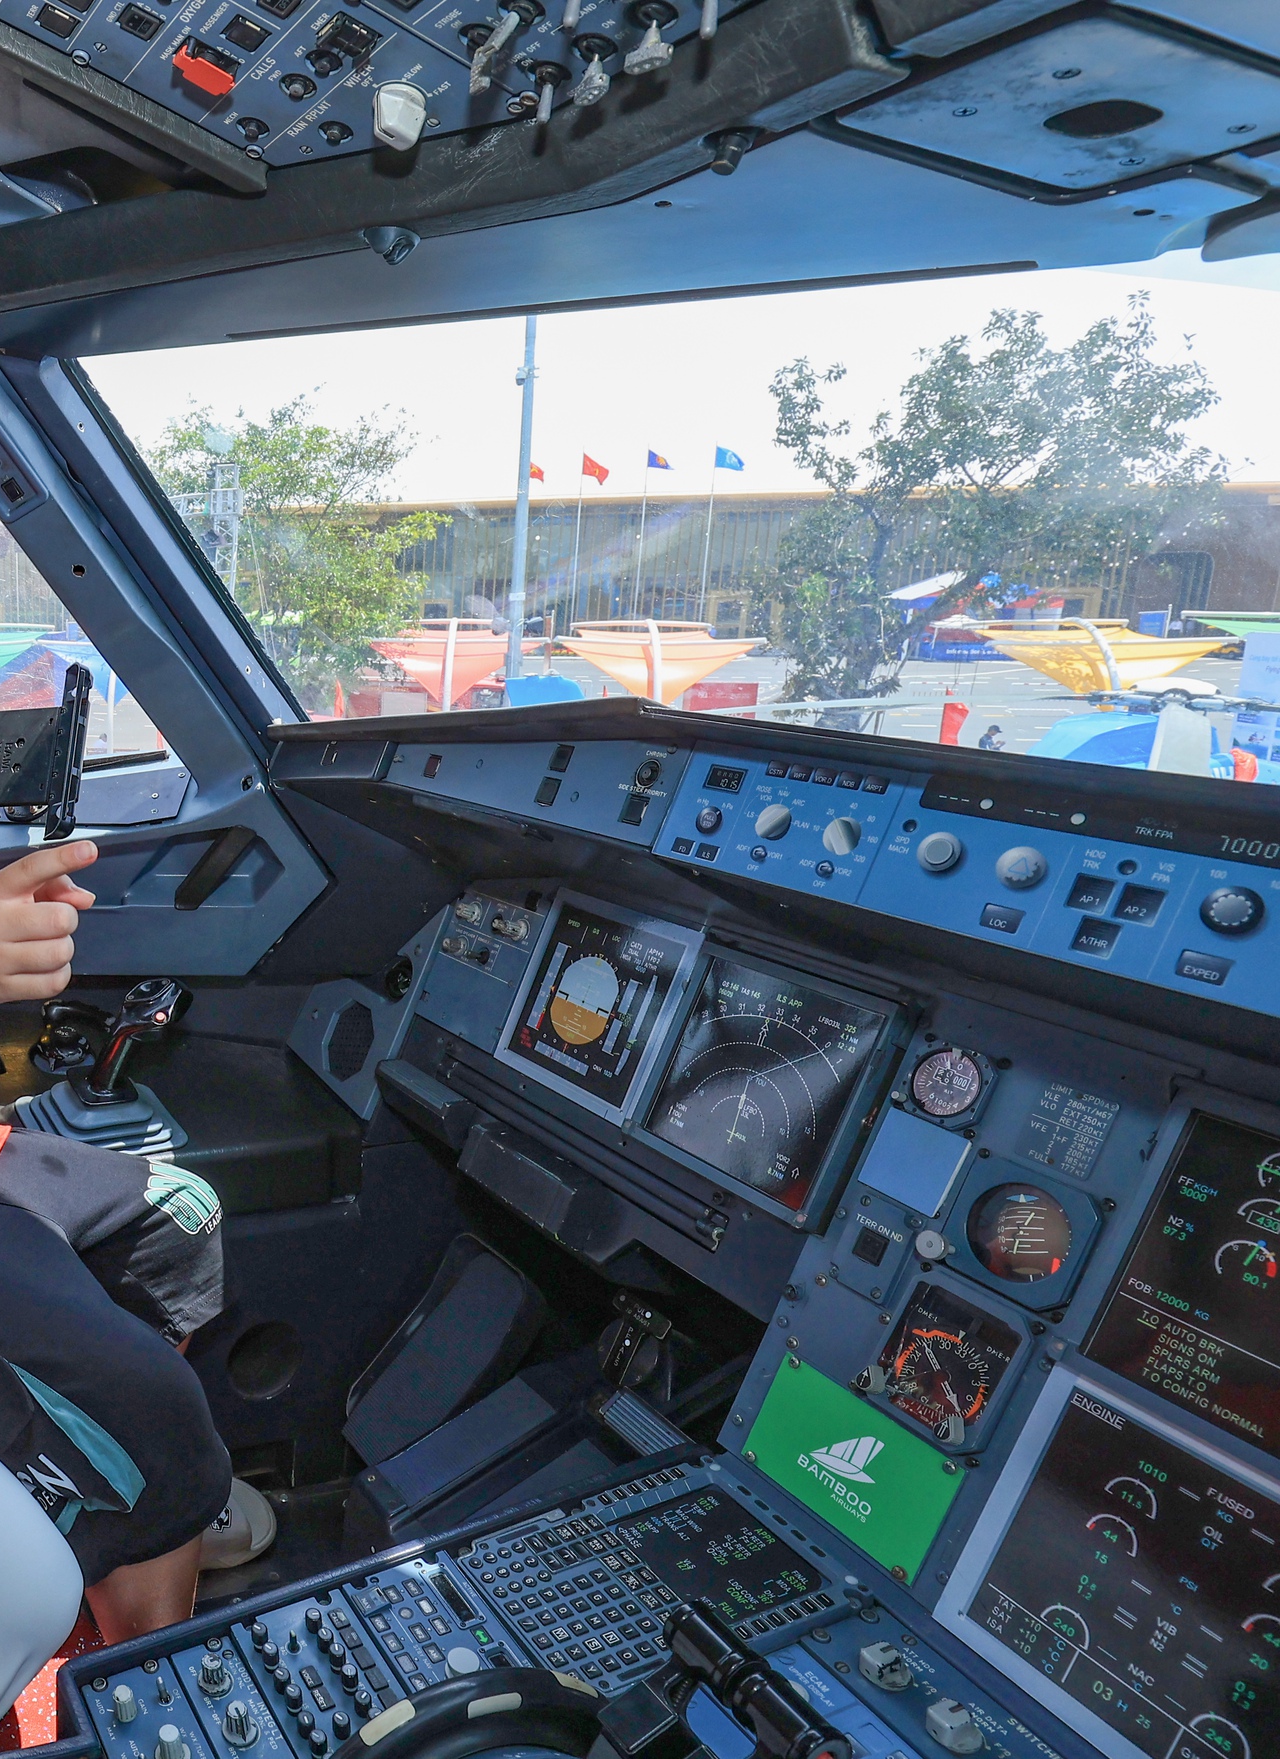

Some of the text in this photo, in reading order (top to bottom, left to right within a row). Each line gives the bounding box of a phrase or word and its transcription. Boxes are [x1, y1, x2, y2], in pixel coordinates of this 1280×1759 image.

[26, 4, 39, 20] TERR
[200, 3, 230, 35] PASSENGER
[434, 10, 463, 29] STROBE
[310, 13, 330, 31] EMER
[537, 21, 553, 33] OFF
[601, 19, 616, 29] ON
[293, 45, 307, 58] AFT
[250, 57, 277, 81] CALLS
[268, 69, 282, 82] FWD
[343, 64, 375, 89] WIPER
[404, 64, 424, 80] SLOW
[361, 76, 374, 88] OFF
[433, 80, 452, 97] FAST
[223, 111, 238, 125] MECH
[287, 101, 332, 138] RAIN RPLNT
[768, 768, 784, 776] CSTR
[793, 772, 806, 780] WPT
[719, 778, 738, 790] 1015
[841, 780, 855, 788] NDB
[866, 784, 883, 793] ARPT
[778, 789, 790, 798] NAV
[791, 798, 806, 807] ARC
[793, 819, 810, 830] PLAN
[1135, 825, 1174, 841] TRK FPA
[678, 845, 687, 853] FD
[735, 843, 752, 853] ADF1
[888, 843, 909, 855] MACH
[894, 835, 911, 845] SPD
[701, 850, 711, 859] ILS
[1085, 847, 1107, 860] HDG
[746, 863, 760, 872] OFF
[799, 858, 816, 869] ADF2
[833, 866, 852, 877] VOR2
[1082, 858, 1101, 870] TRK
[1158, 861, 1176, 874] V/S
[812, 879, 827, 889] OFF
[1150, 871, 1172, 884] FPA
[1078, 894, 1094, 905] AP
[1123, 905, 1139, 915] AP
[988, 917, 1007, 929] LOC
[1078, 934, 1109, 950] A/THR
[1182, 964, 1220, 982] EXPED
[775, 993, 804, 1009] ILS APP
[843, 1023, 858, 1035] 325
[1052, 1083, 1073, 1096] LIMIT
[1041, 1099, 1108, 1129] VLO EXT 250KT
[1044, 1091, 1113, 1120] VLE 280KT/M67
[1031, 1121, 1099, 1147] VFE 230KT
[1059, 1117, 1104, 1138] RET 220KT
[1052, 1133, 1096, 1155] 1+F 215KT
[1027, 1149, 1086, 1177] FULL 177KT
[1067, 1150, 1093, 1163] 200KT
[1177, 1175, 1219, 1197] FF KG/H
[1179, 1185, 1208, 1203] 3000
[855, 1212, 904, 1244] TERR ON ND
[1167, 1214, 1185, 1229] N2
[1162, 1225, 1188, 1242] 97.3
[1242, 1272, 1269, 1290] 90.1
[1128, 1277, 1212, 1322] FOB: 12000 KG
[917, 1307, 940, 1324] DME-L
[1141, 1309, 1226, 1358] T.O AUTO BRK
[986, 1346, 1012, 1364] DME-R
[1158, 1333, 1218, 1369] SIGNS ON
[1152, 1344, 1222, 1385] SPLRS ARM
[1146, 1356, 1208, 1393] FLAPS T.O
[1071, 1392, 1127, 1428] ENGINE
[1141, 1367, 1266, 1440] T.O CONFIG NORMAL
[1137, 1459, 1169, 1484] 1010
[796, 1452, 872, 1517] BAMBOO
[829, 1493, 868, 1525] AIRWAYS
[1120, 1490, 1143, 1510] 11.5
[1205, 1486, 1256, 1520] F.USED
[1215, 1508, 1235, 1525] KG
[754, 1527, 776, 1546] APPR
[1101, 1529, 1119, 1544] 44
[1200, 1536, 1220, 1552] QT
[1202, 1525, 1225, 1545] OIL
[708, 1540, 730, 1559] CLEAN
[1093, 1550, 1109, 1566] 15
[779, 1570, 808, 1593] ILS33R
[727, 1578, 760, 1606] LDG CONF
[717, 1601, 740, 1620] FULL
[997, 1594, 1018, 1613] TAT
[991, 1605, 1013, 1625] SAT
[985, 1616, 1004, 1635] ISA
[1023, 1616, 1043, 1634] +10
[1052, 1617, 1076, 1638] 240
[1155, 1615, 1179, 1637] VIB
[903, 1646, 937, 1676] ATT HDG
[1248, 1652, 1270, 1671] 20
[301, 1668, 314, 1688] VOICE
[788, 1665, 812, 1688] UPPER
[803, 1669, 831, 1694] ECAM
[1126, 1662, 1156, 1688] NAC
[808, 1683, 837, 1709] DISPLAY
[1091, 1679, 1115, 1702] 03
[203, 1696, 214, 1710] BRT
[312, 1689, 327, 1711] RESET
[256, 1700, 277, 1729] INTEG
[968, 1701, 1009, 1737] AIR DATA
[969, 1711, 996, 1735] NORM
[1135, 1713, 1153, 1730] 25
[1204, 1727, 1233, 1752] 245
